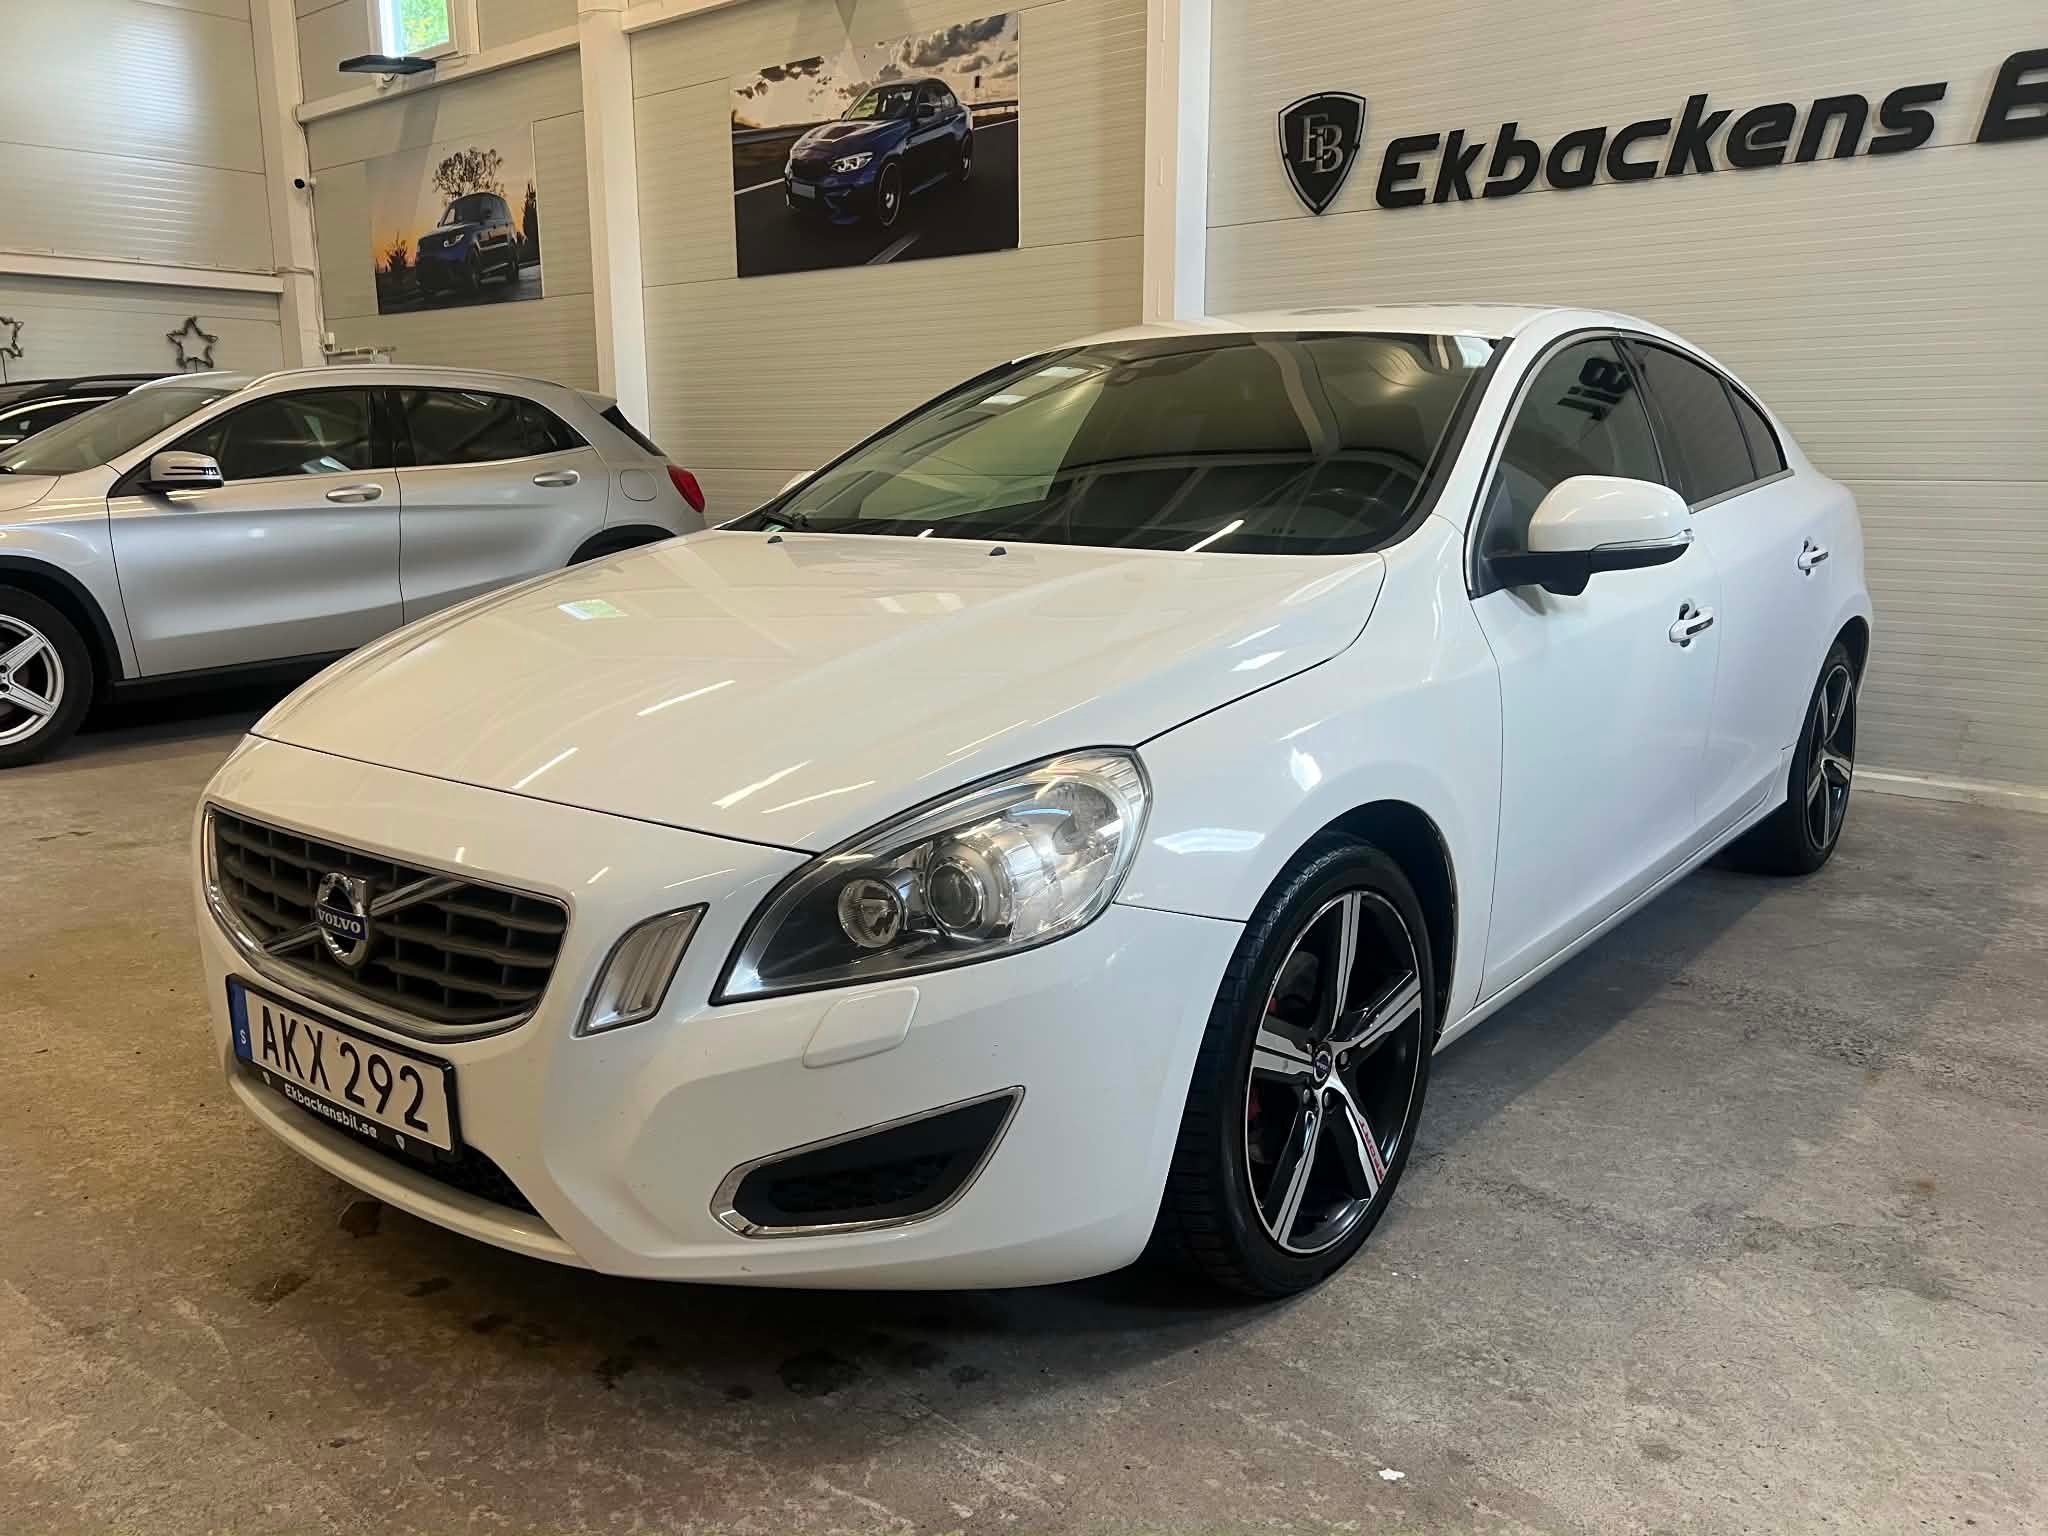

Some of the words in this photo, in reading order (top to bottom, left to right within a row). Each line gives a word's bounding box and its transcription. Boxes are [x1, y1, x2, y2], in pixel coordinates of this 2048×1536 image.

[1376, 82, 1948, 208] Ekbackens
[317, 910, 361, 934] VOLVO
[239, 1029, 247, 1045] S
[261, 1005, 331, 1093] AKX
[339, 1041, 428, 1133] 292
[283, 1082, 378, 1139] Ekbackensbil.se
